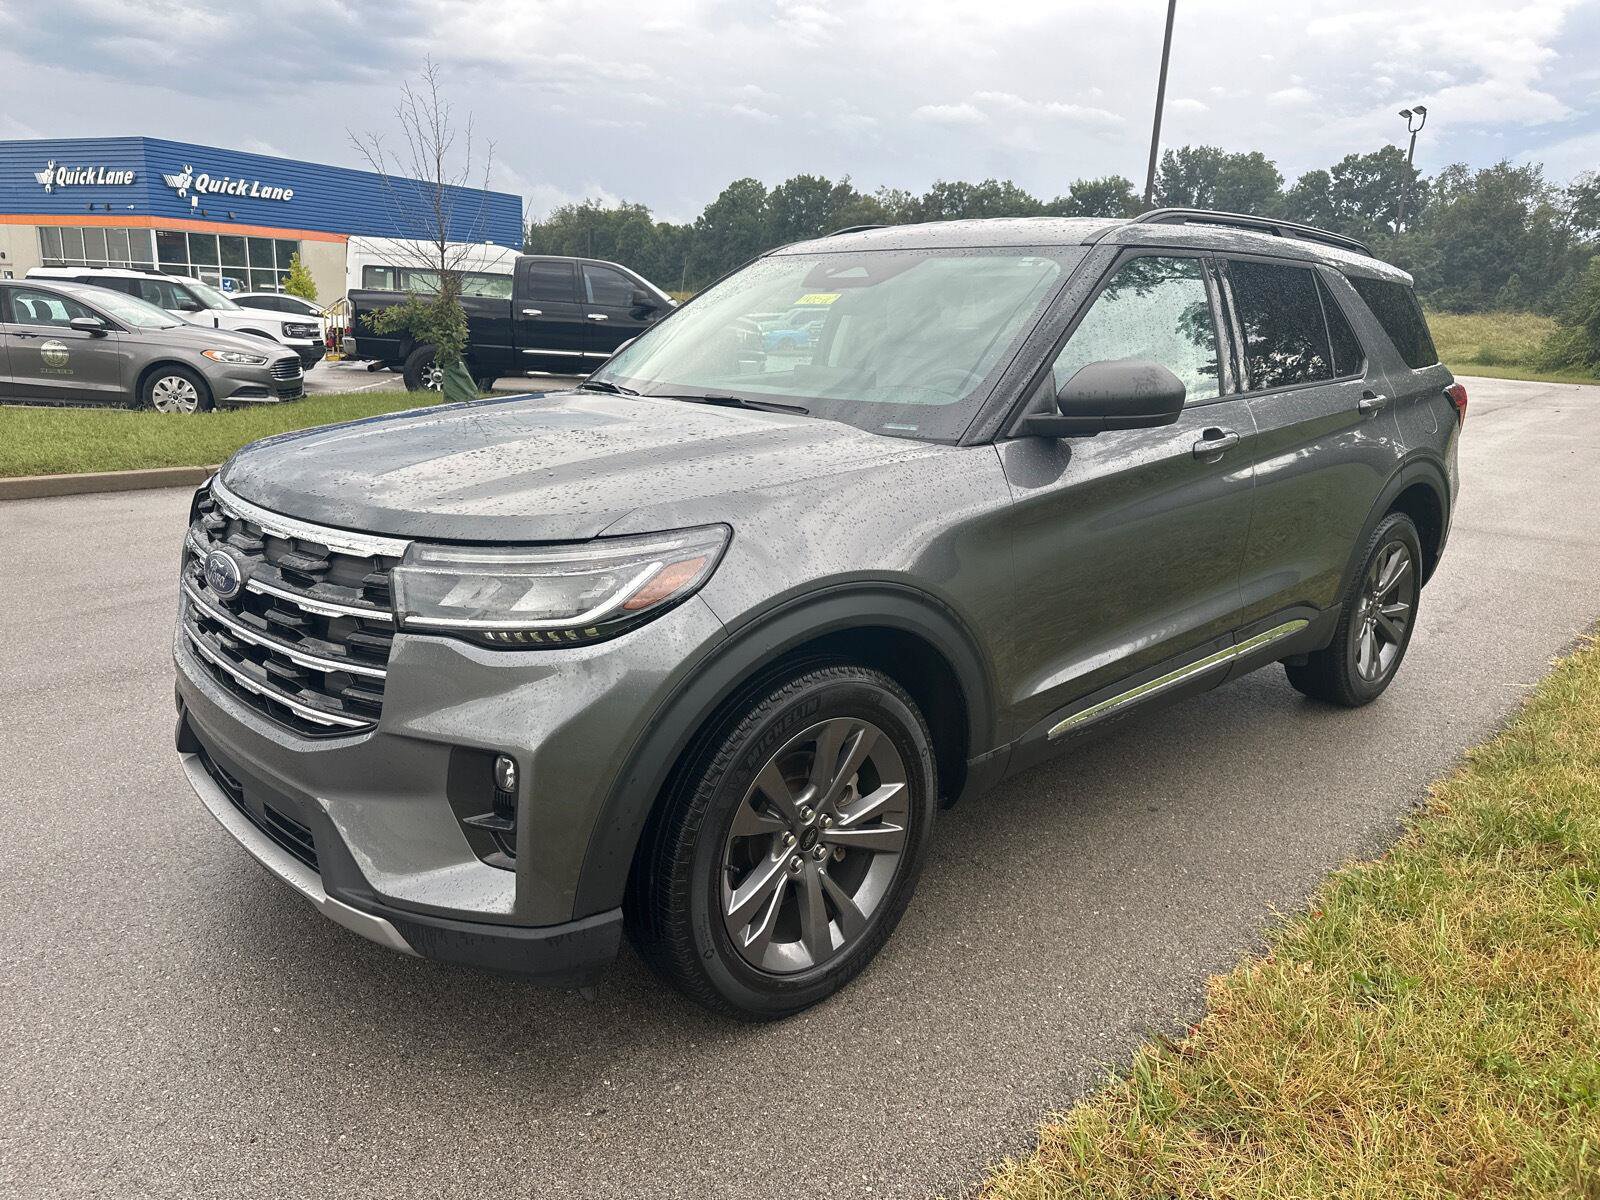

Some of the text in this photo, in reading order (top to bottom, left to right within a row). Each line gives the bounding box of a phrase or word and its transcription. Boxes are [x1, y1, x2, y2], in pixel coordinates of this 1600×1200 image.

[56, 166, 134, 186] Quick Lane
[195, 173, 294, 201] Quick Lane
[747, 695, 821, 767] MICHELIN
